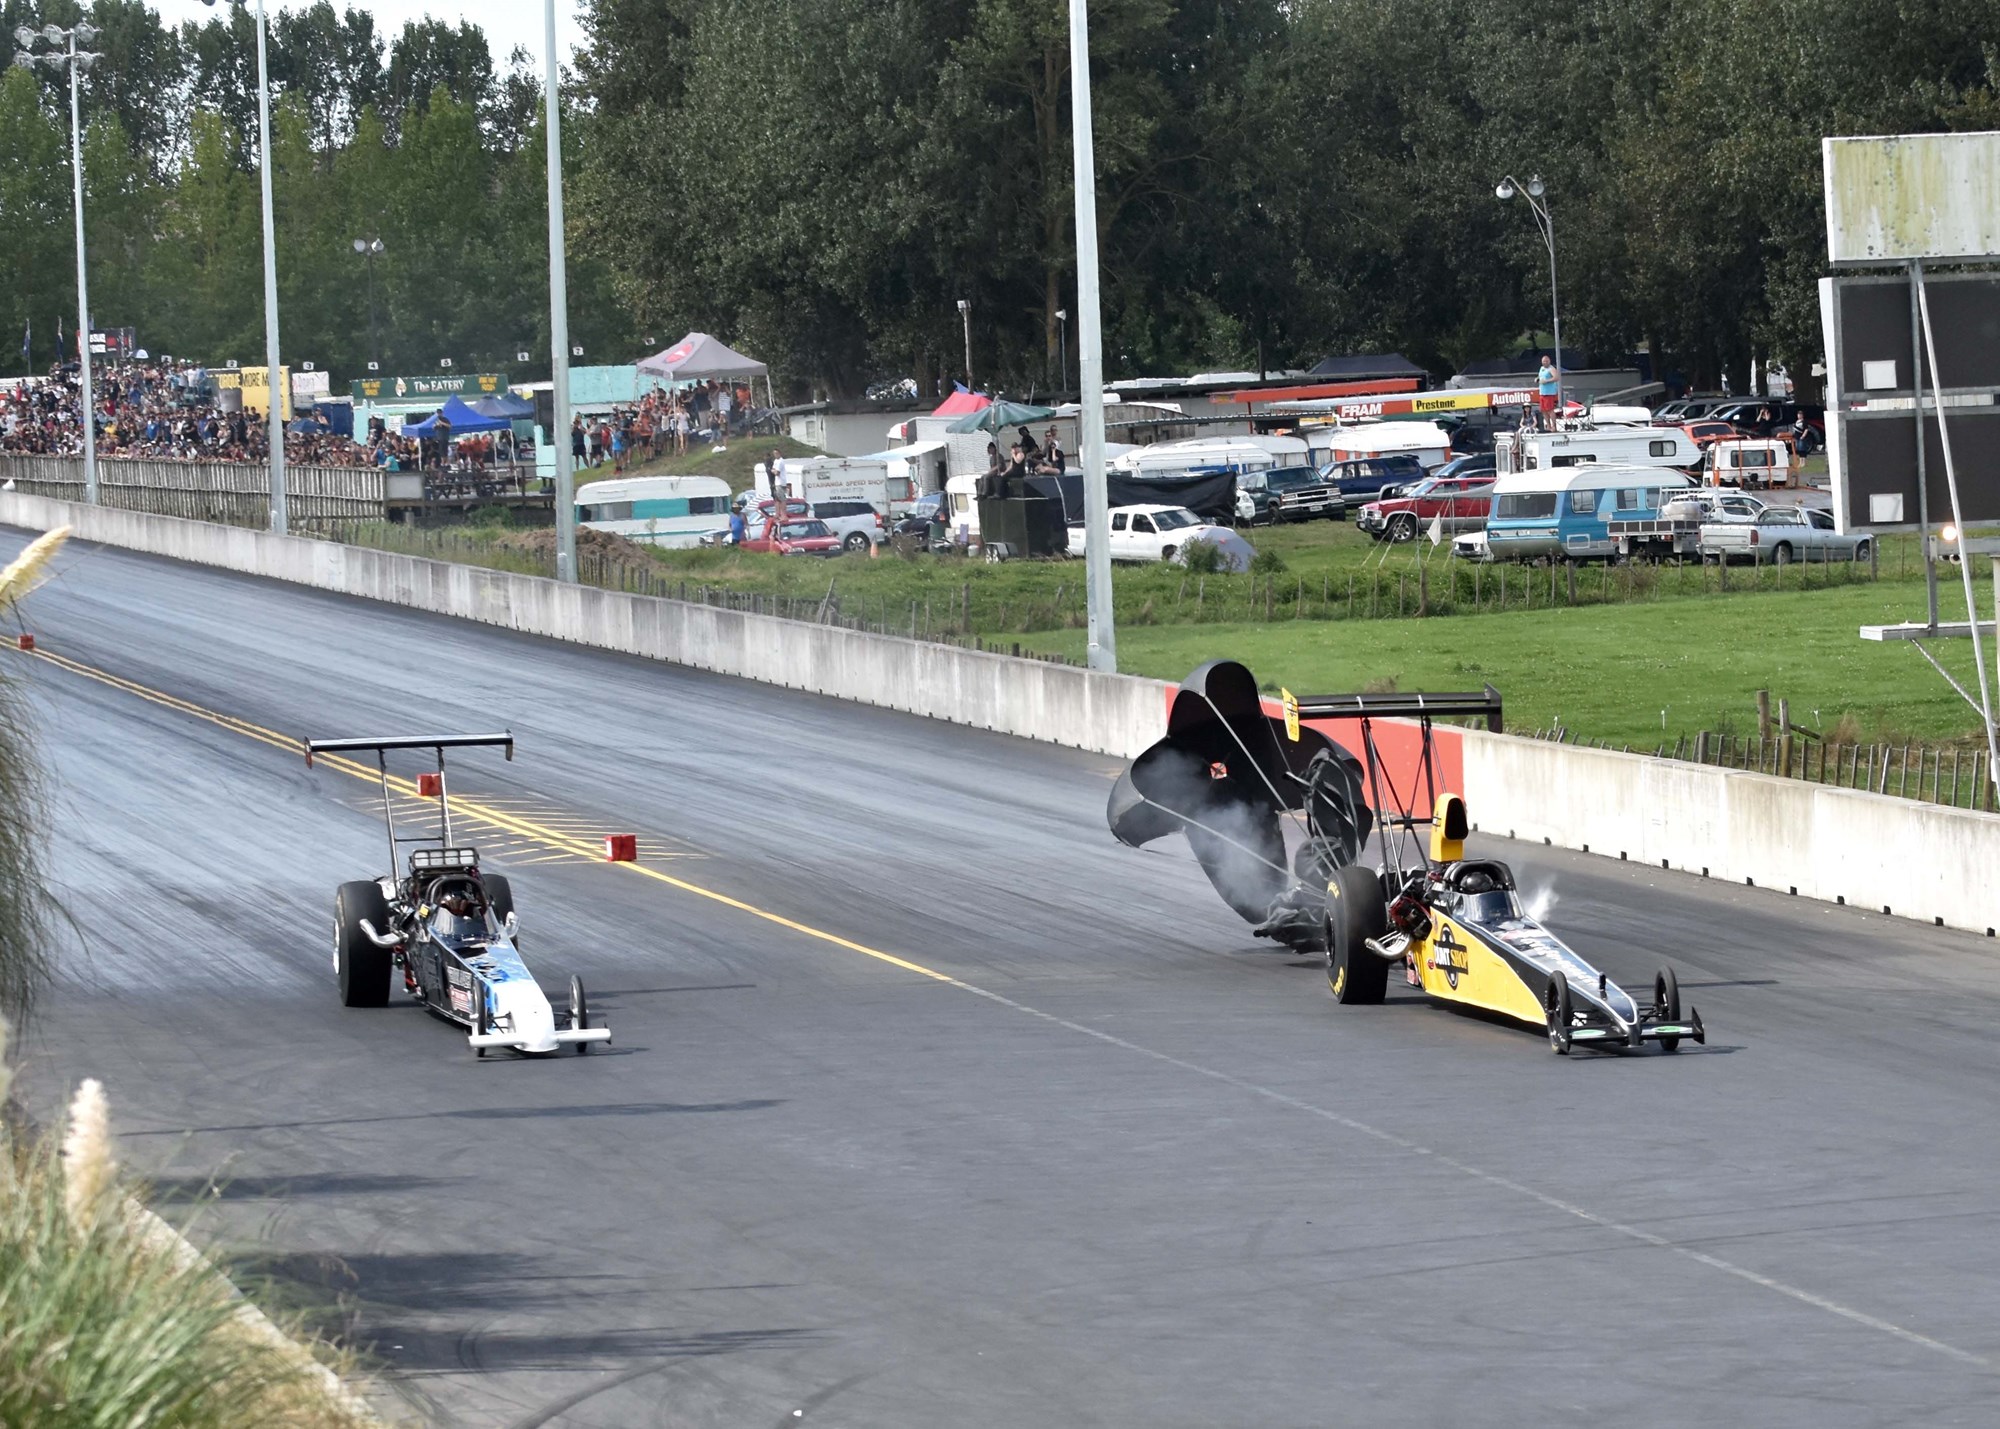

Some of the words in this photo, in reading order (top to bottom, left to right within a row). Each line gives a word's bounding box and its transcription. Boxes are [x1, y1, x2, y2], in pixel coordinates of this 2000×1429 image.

[414, 381, 430, 392] The
[431, 379, 465, 391] EATERY
[1416, 399, 1455, 410] Prestone
[1492, 392, 1531, 405] Autolite
[1341, 403, 1382, 417] FRAM
[1450, 949, 1468, 969] SHOP
